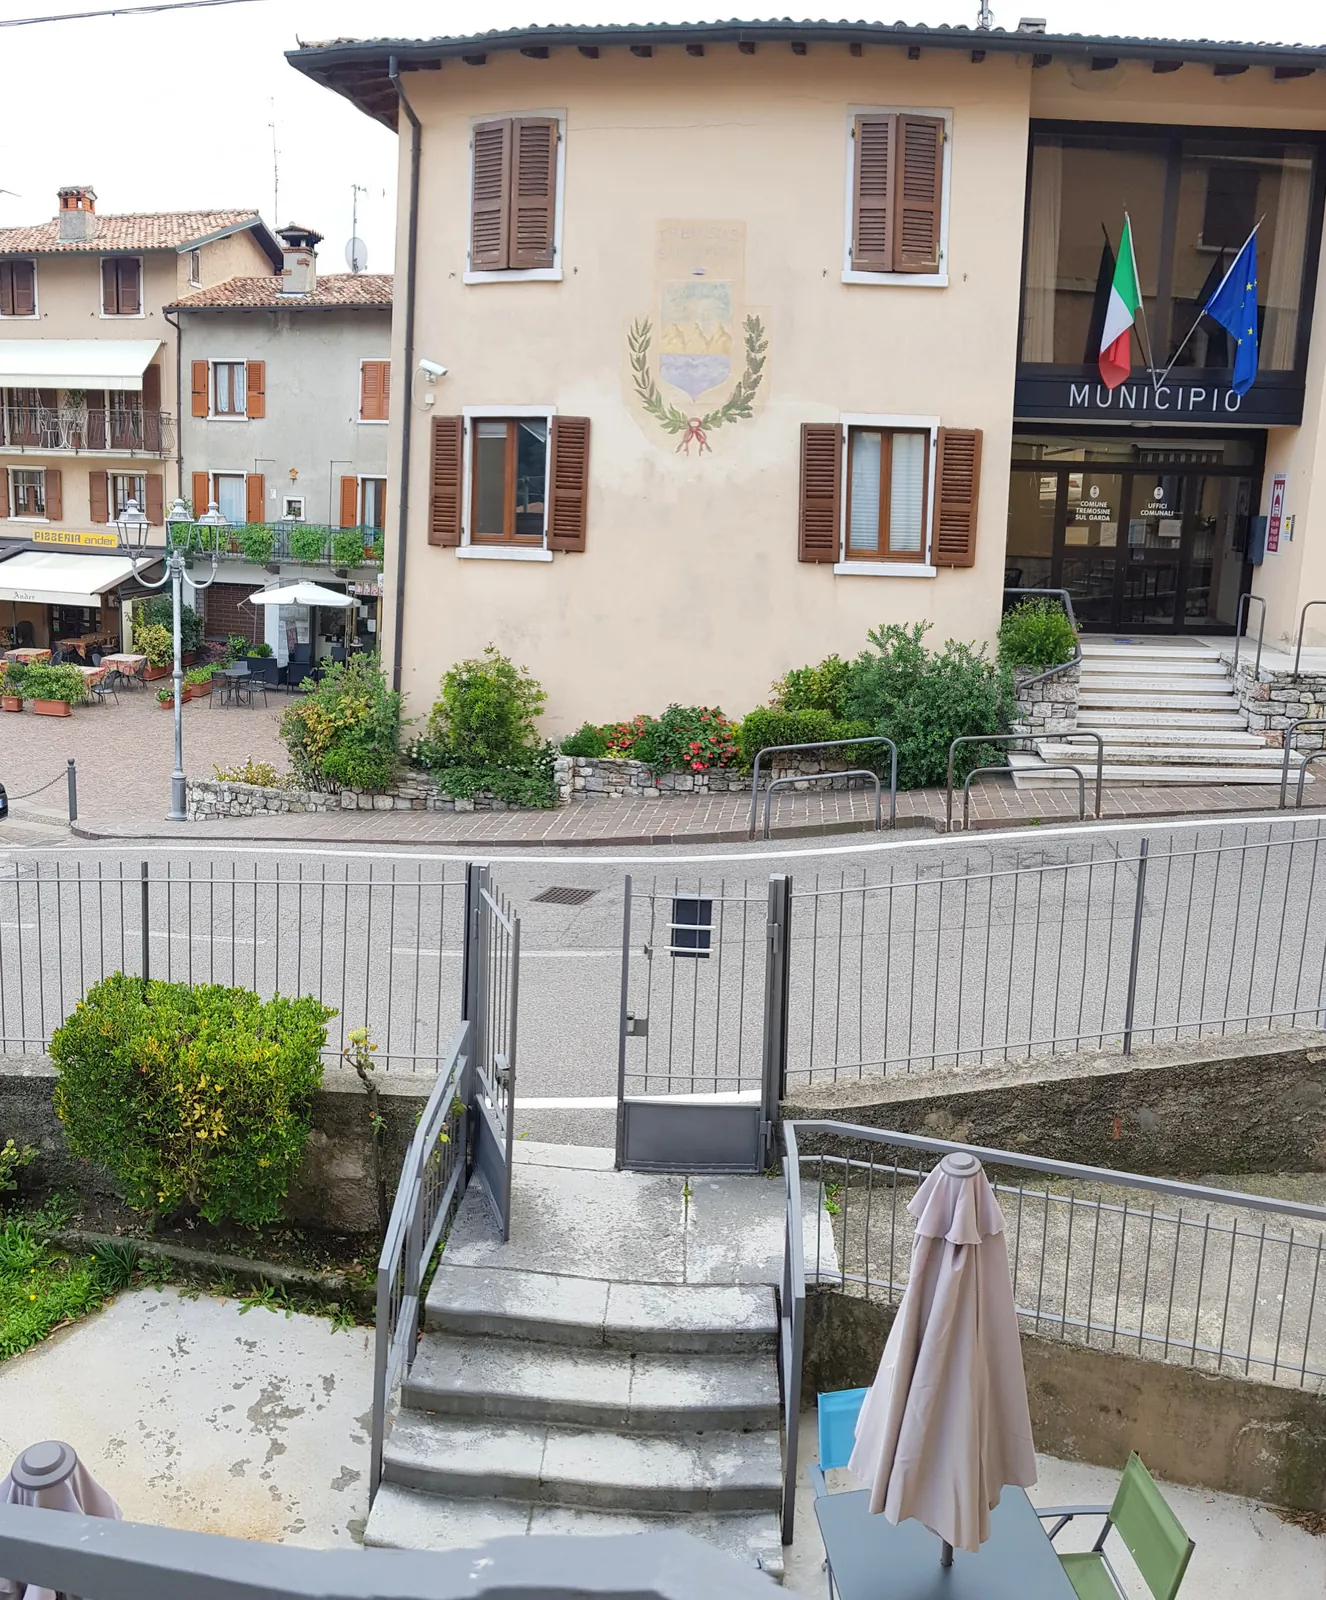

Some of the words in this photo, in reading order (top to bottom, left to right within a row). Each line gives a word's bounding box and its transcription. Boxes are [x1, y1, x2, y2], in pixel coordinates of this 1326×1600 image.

[1069, 383, 1241, 412] MUNICIPIO
[1080, 500, 1108, 508] COMUNE
[1075, 507, 1111, 515] TREMOSINE
[1140, 509, 1174, 517] COMUNALI
[1088, 514, 1111, 522] GARDA
[34, 531, 81, 543] PIZZERIA
[84, 536, 116, 546] ander
[12, 591, 36, 601] Ander
